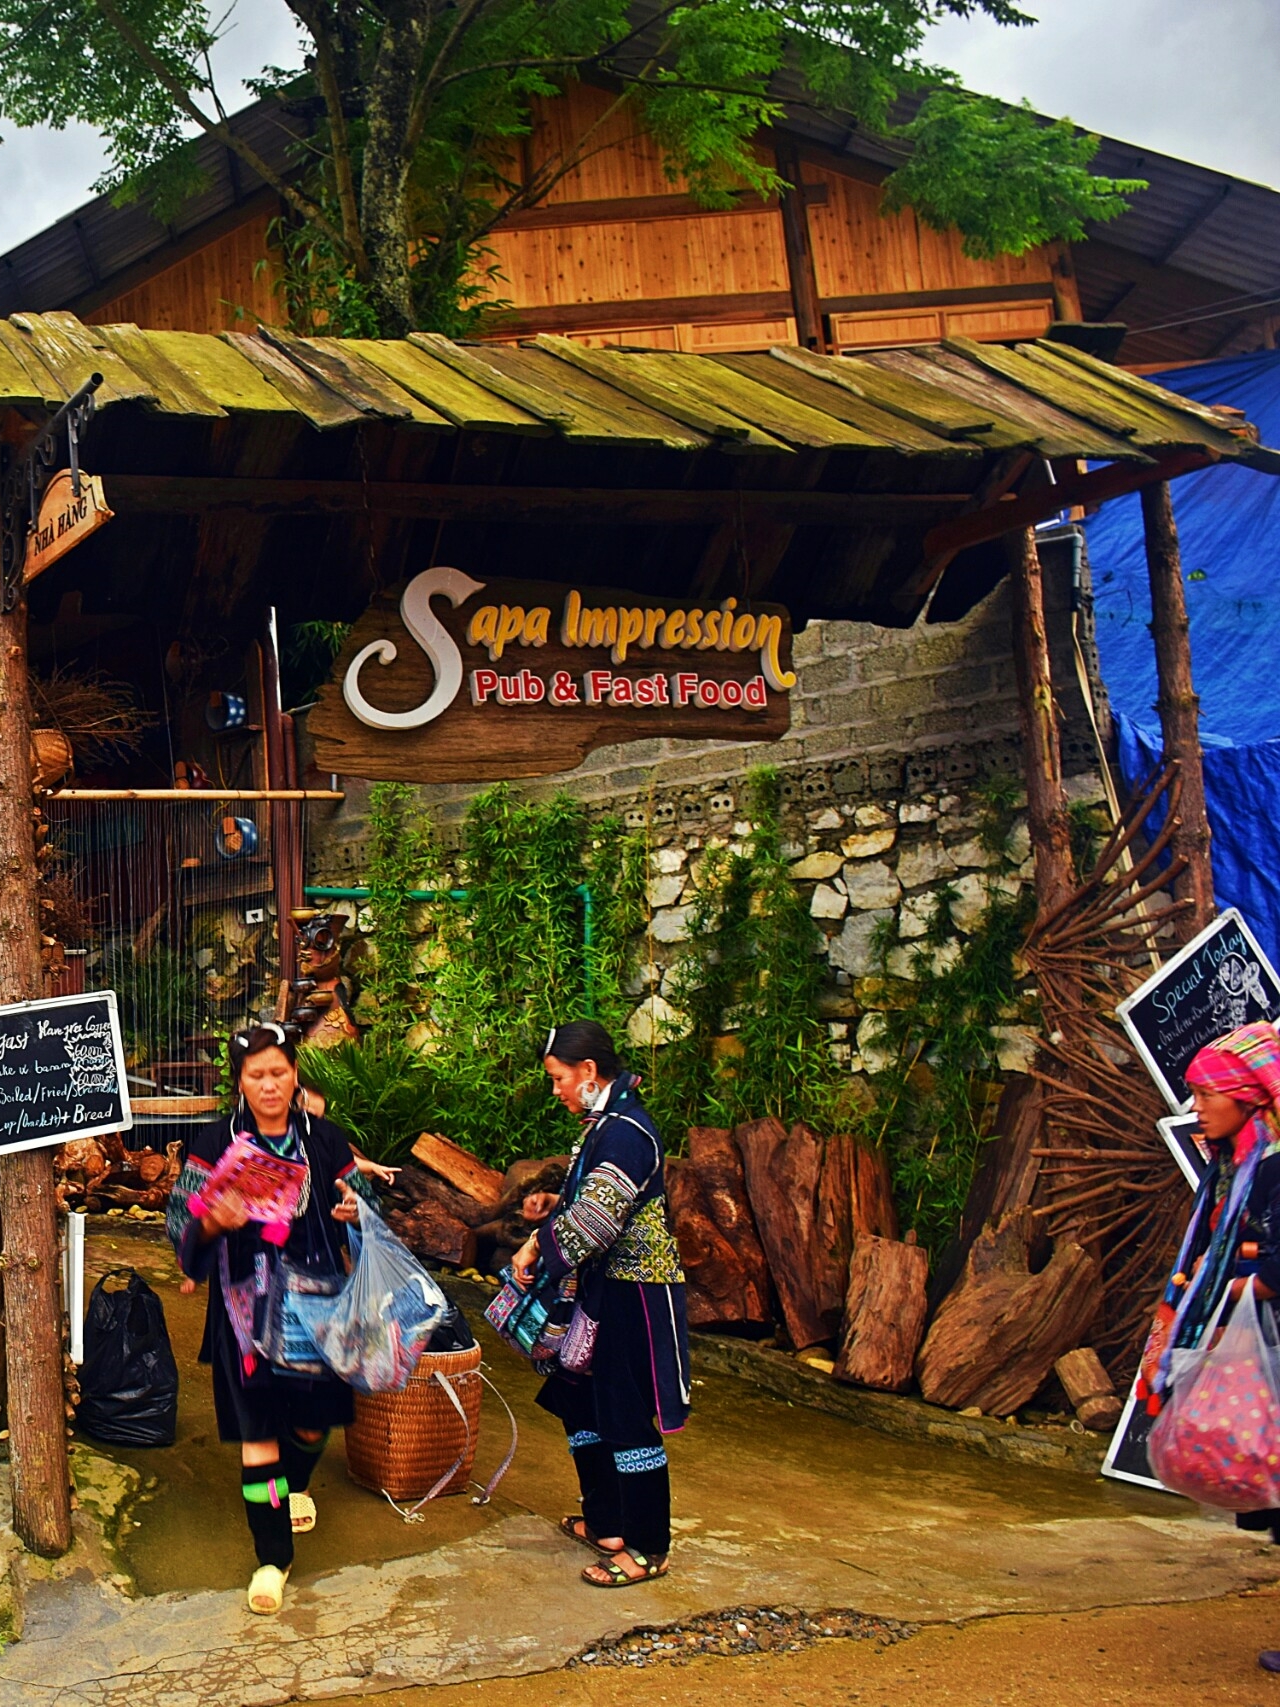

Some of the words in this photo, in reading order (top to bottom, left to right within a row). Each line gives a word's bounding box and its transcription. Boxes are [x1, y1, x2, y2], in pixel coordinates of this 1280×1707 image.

[34, 518, 56, 556] NHÀ
[57, 496, 88, 538] HÀNG
[343, 566, 552, 731] Sapa
[559, 588, 797, 692] Impression
[470, 668, 545, 706] Pub
[548, 670, 581, 706] &
[584, 669, 670, 706] Fast
[671, 671, 768, 711] Food
[1152, 959, 1205, 1024] Special
[1202, 931, 1247, 969] Today
[72, 1103, 114, 1124] Bread
